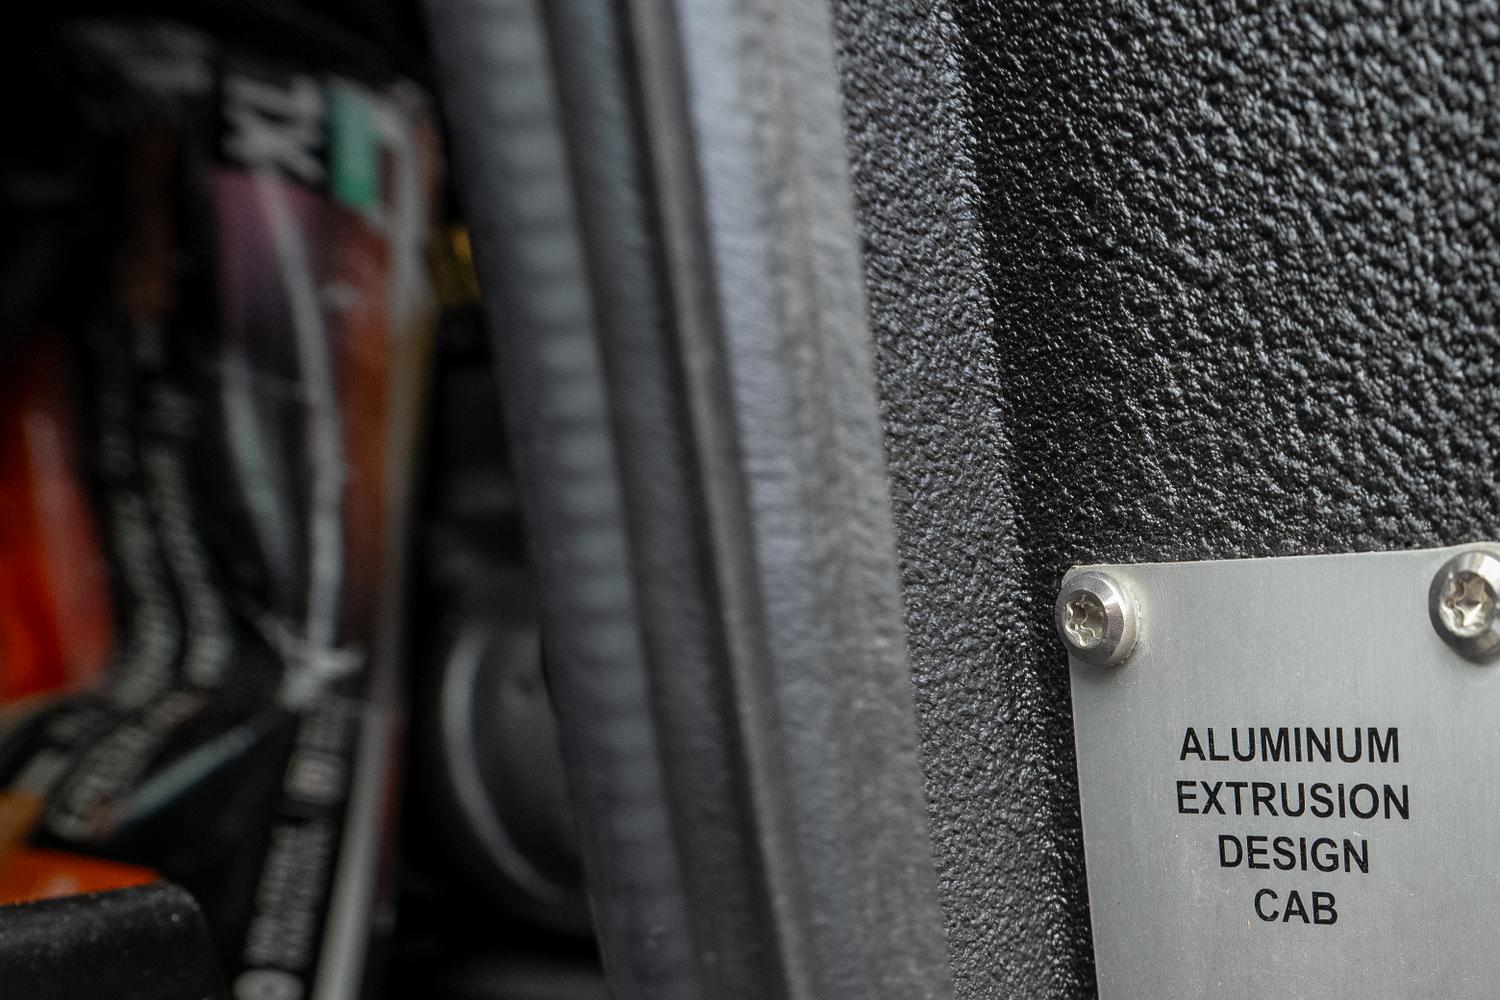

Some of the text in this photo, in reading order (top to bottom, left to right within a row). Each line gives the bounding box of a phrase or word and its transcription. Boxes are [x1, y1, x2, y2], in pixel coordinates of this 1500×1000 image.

[1179, 727, 1400, 763] ALUMINUM
[1176, 780, 1410, 820] EXTRUSION
[1218, 834, 1369, 874] DESIGN
[1254, 888, 1338, 925] CAB
